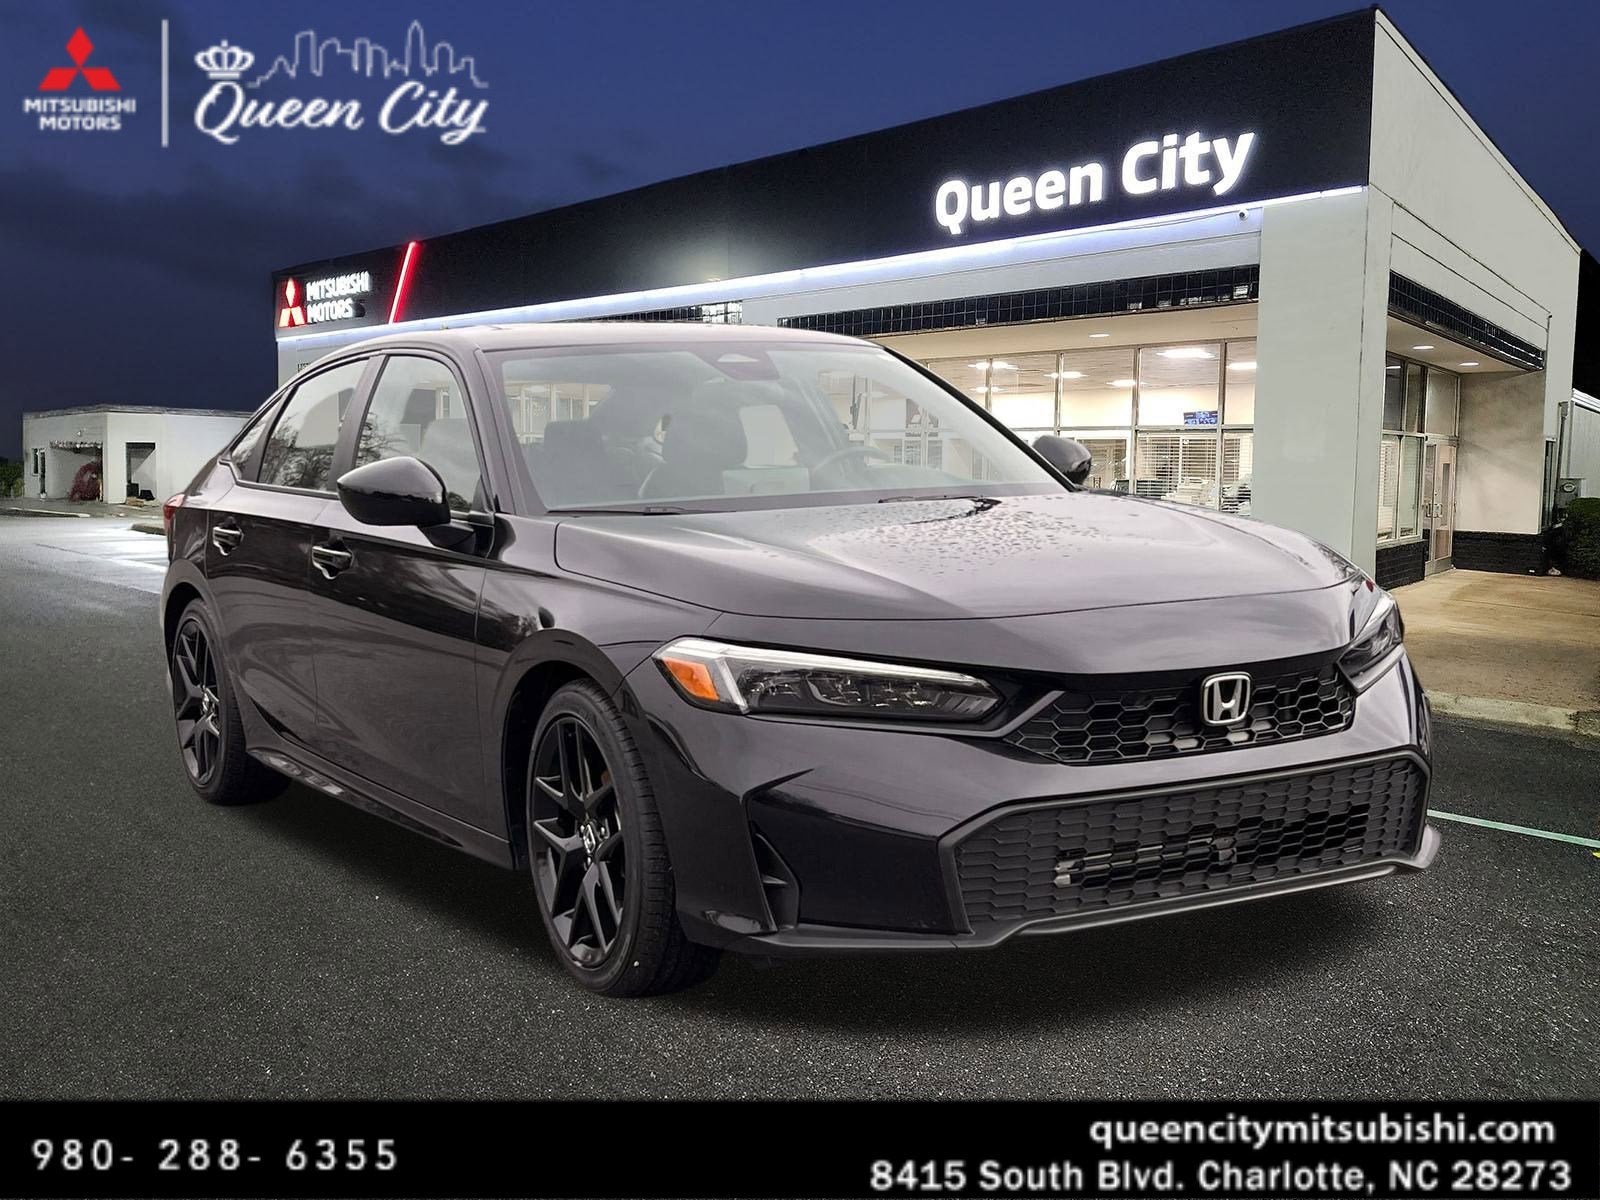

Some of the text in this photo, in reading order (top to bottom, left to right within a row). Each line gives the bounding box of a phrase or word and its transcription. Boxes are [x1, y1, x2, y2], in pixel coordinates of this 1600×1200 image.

[935, 131, 1255, 235] Queen City
[306, 271, 370, 301] MITSUBISHI
[306, 298, 354, 324] MOTORS
